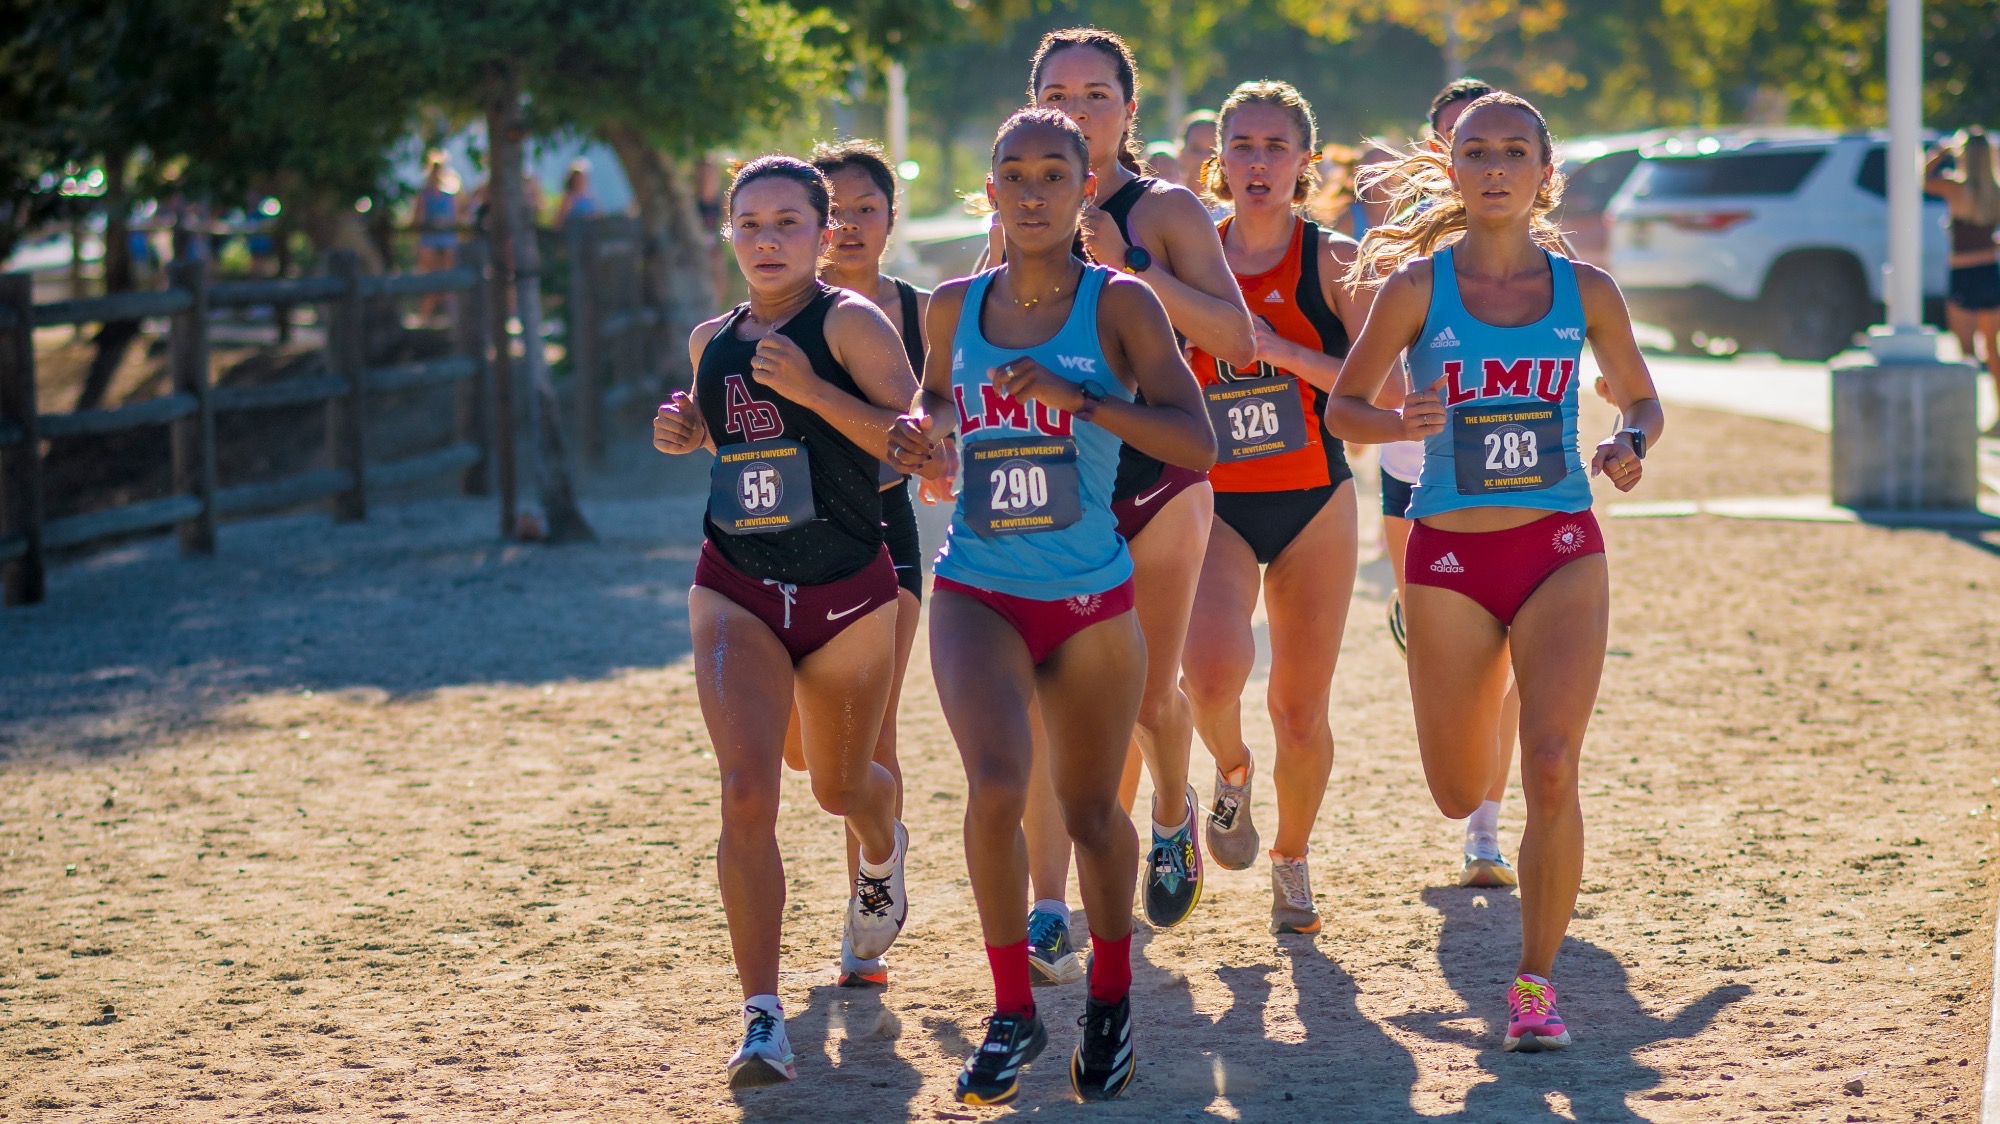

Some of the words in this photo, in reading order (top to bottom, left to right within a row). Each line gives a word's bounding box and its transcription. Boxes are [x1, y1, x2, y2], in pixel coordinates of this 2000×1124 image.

[1430, 338, 1461, 349] adidas
[1057, 354, 1096, 374] WCC
[1443, 357, 1575, 409] LMU
[1209, 393, 1221, 401] THE
[1221, 389, 1251, 400] MASTER'S
[1252, 383, 1289, 395] UNIVERSITY
[953, 383, 1074, 437] LMU
[1228, 402, 1279, 441] 326
[1465, 416, 1478, 425] THE
[1479, 413, 1513, 423] MASTER'S
[1514, 411, 1553, 421] UNIVERSITY
[721, 455, 732, 463] THE
[732, 451, 760, 462] MASTER'S
[761, 448, 797, 459] UNIVERSITY
[974, 452, 987, 460] THE
[987, 448, 1019, 459] MASTER'S
[1020, 446, 1065, 456] UNIVERSITY
[1232, 448, 1242, 456] XC
[1242, 441, 1286, 454] INVITATIONAL
[1484, 430, 1538, 470] 283
[990, 466, 1048, 510] 290
[1484, 479, 1494, 487] XC
[1495, 476, 1542, 486] INVITATIONAL
[743, 470, 776, 509] 55
[735, 519, 744, 528] XC
[744, 515, 790, 527] INVITATIONAL
[990, 520, 1001, 529] XC
[1001, 515, 1054, 528] INVITATIONAL
[1430, 563, 1465, 574] adidas
